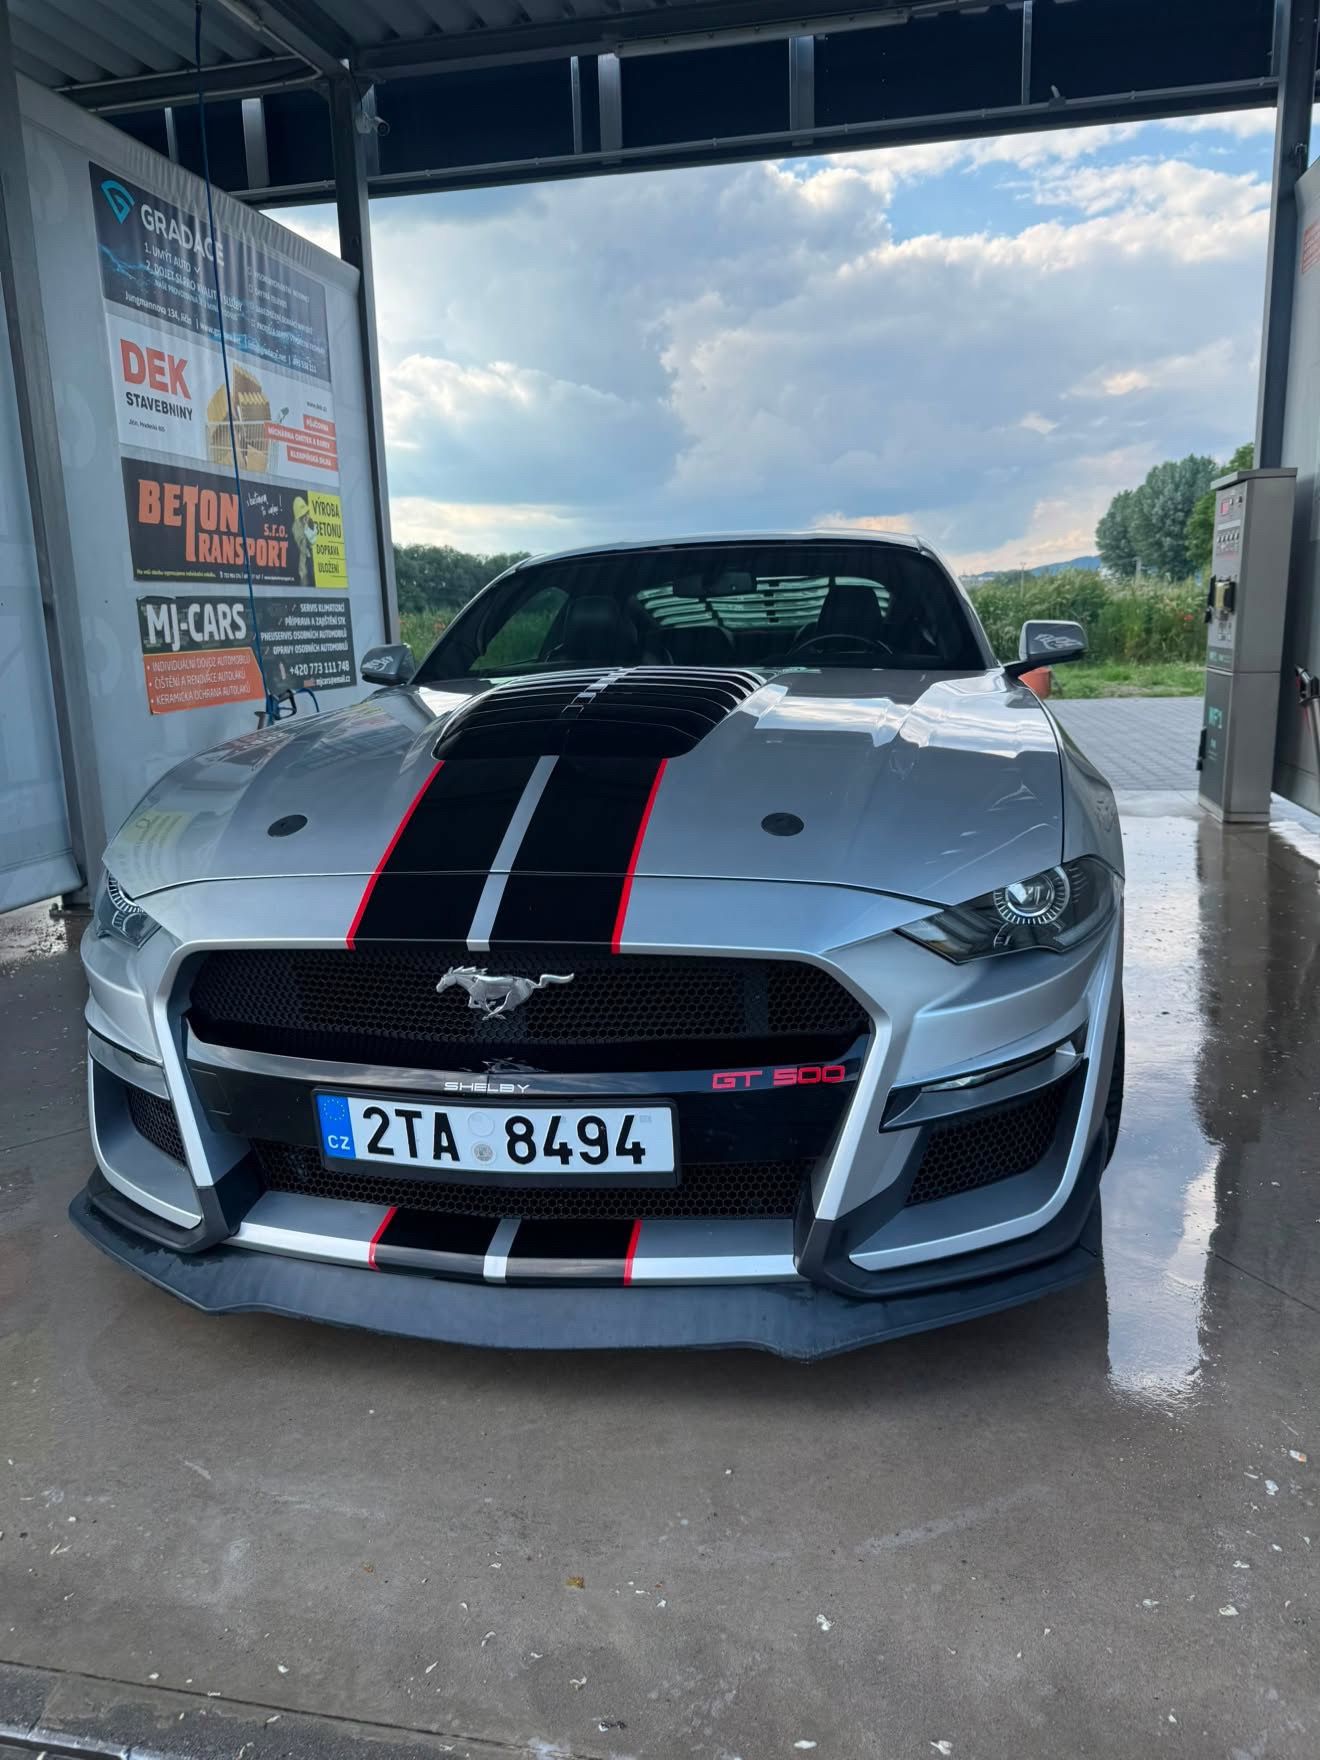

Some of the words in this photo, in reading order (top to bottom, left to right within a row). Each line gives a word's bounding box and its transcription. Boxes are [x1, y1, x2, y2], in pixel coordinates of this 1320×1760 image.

[141, 204, 224, 267] GRADACE
[144, 242, 151, 254] 1.
[174, 256, 192, 272] AUTO
[126, 291, 166, 315] Jungmannova
[120, 338, 192, 400] DEK
[126, 392, 192, 421] STAVEBNINY
[138, 479, 239, 535] BETON
[312, 497, 340, 518] VÝROBA
[264, 524, 288, 538] s.r.o.
[313, 520, 342, 538] BETONU
[316, 544, 340, 556] DOPRAVA
[146, 603, 246, 652] MJ-CARS
[260, 631, 293, 641] PNEUSERVIS
[294, 629, 318, 640] OSOBNÍCH
[273, 646, 294, 655] OPRAVY
[295, 642, 320, 654] OSOBNÍCH
[289, 664, 309, 676] +420
[309, 662, 323, 675] 773
[324, 662, 337, 673] 111
[443, 1081, 531, 1094] SHELBY
[712, 1070, 763, 1089] GT
[773, 1065, 846, 1086] 500
[328, 1134, 350, 1150] CZ
[362, 1106, 460, 1162] 2TA
[504, 1114, 646, 1165] 8494
